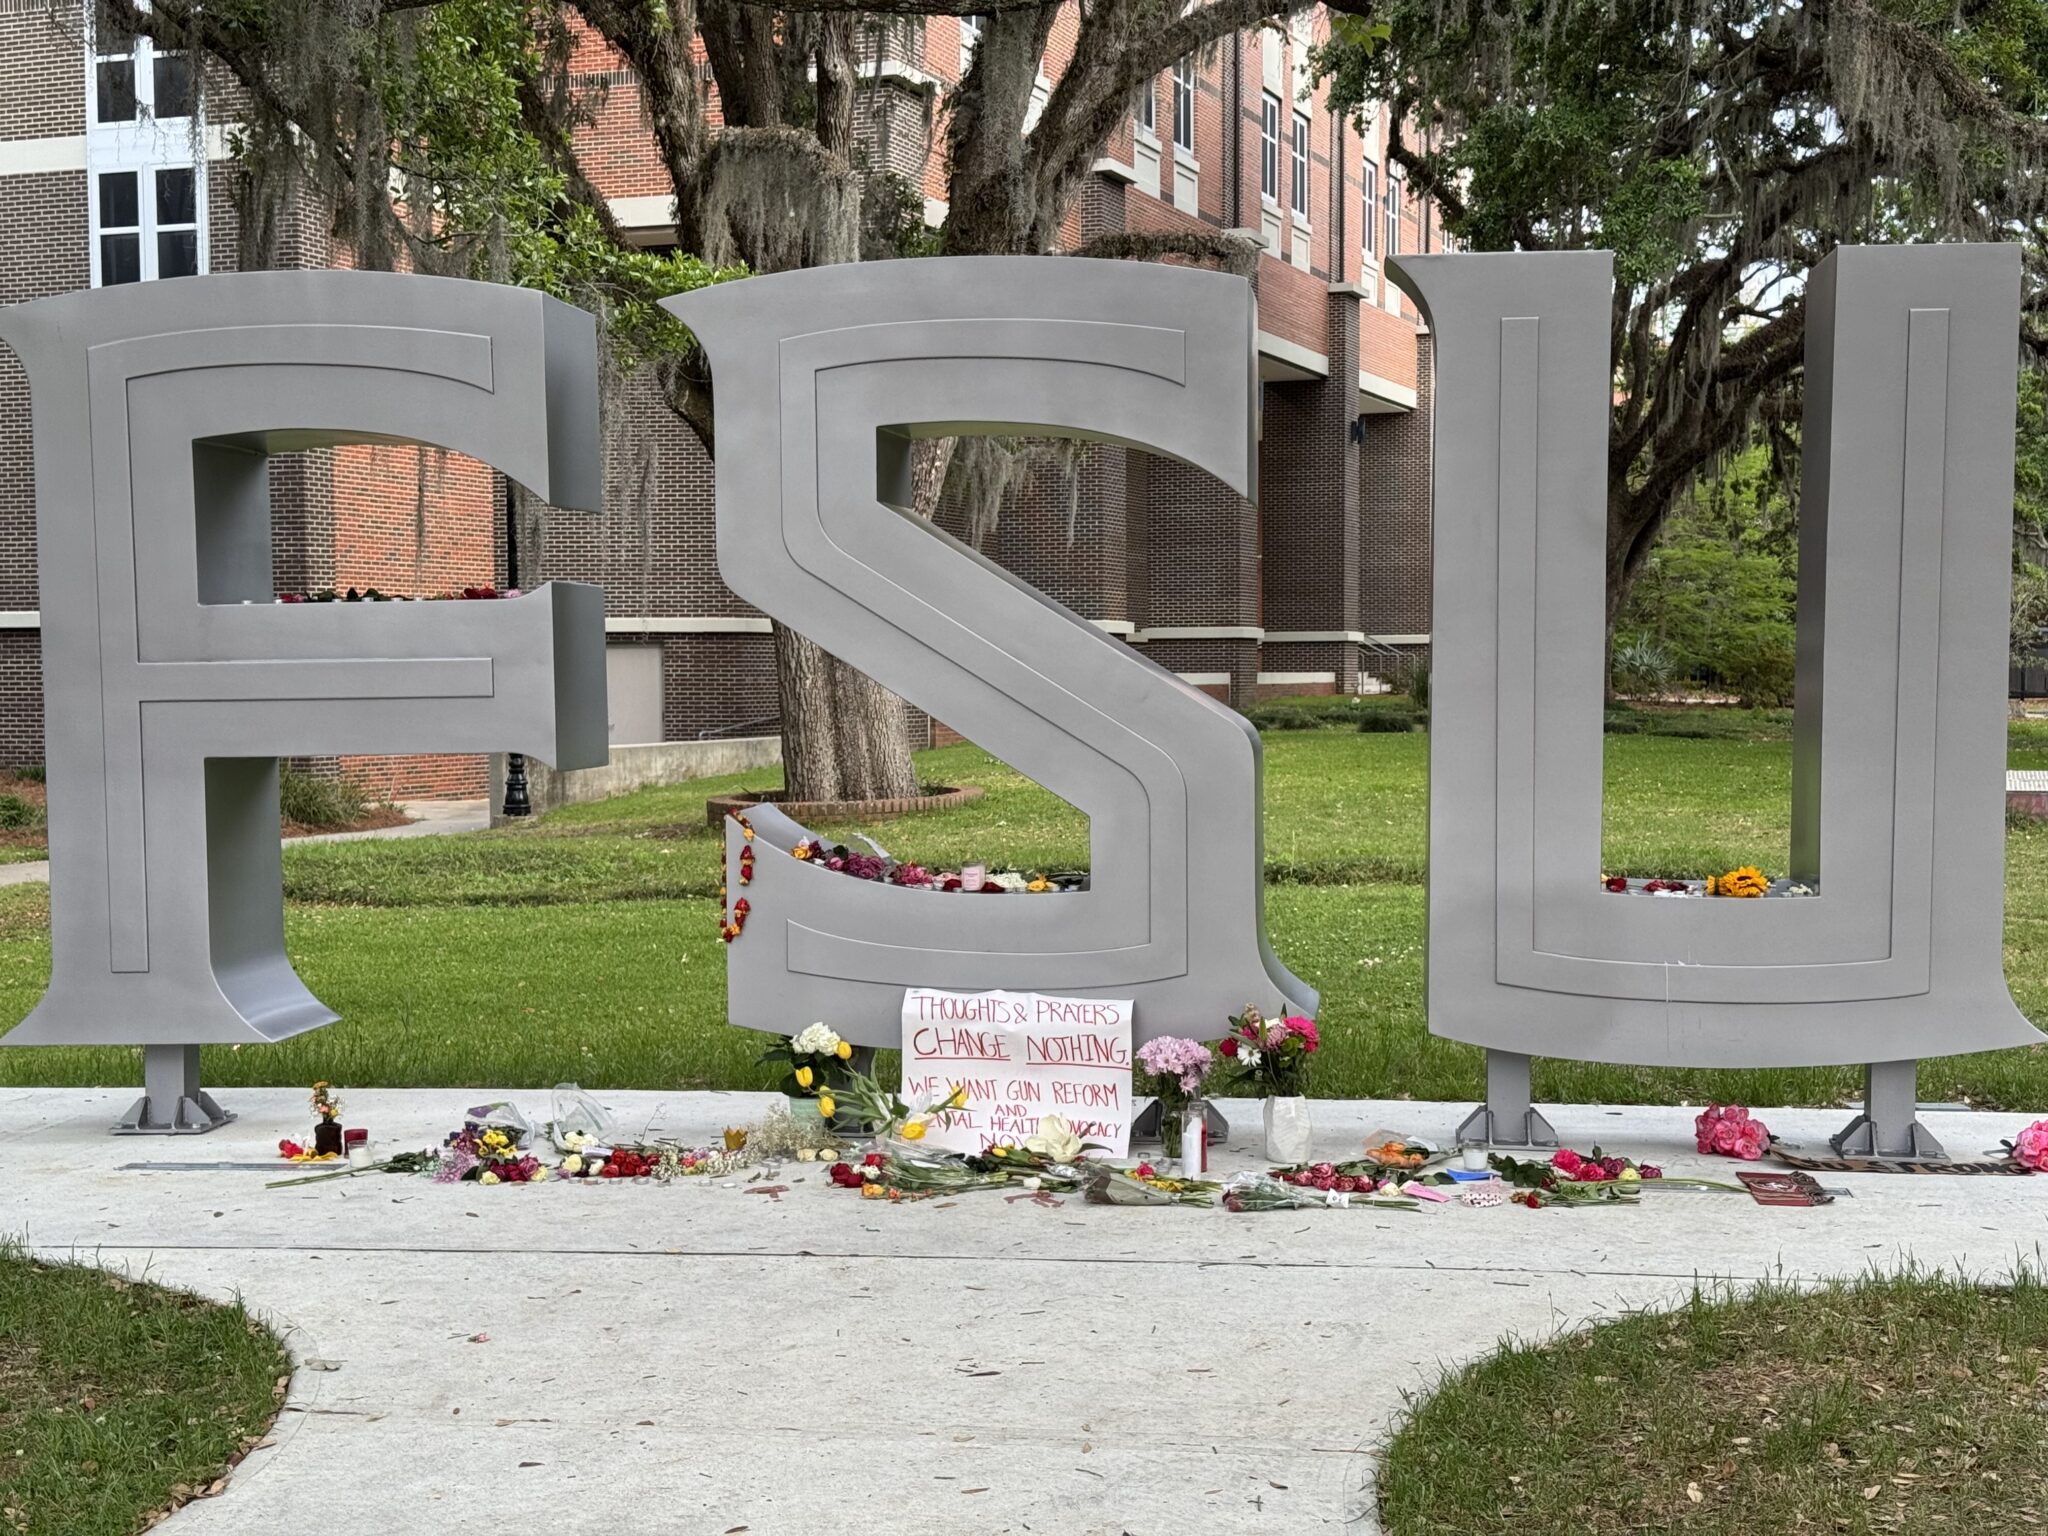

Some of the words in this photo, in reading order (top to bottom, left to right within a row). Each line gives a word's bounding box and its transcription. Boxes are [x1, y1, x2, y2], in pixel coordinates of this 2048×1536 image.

[0, 242, 2047, 1070] FSU
[911, 996, 1010, 1023] THOUGHTS
[1013, 1002, 1027, 1024] &
[1036, 1000, 1120, 1025] PRAYERS
[913, 1027, 1010, 1058] CHANGE
[1026, 1033, 1130, 1066] NOTHING.
[908, 1076, 940, 1097] WE
[1006, 1080, 1041, 1102] GUN
[1052, 1081, 1119, 1111] REFORM
[927, 1110, 983, 1129] NTAL
[1066, 1119, 1122, 1138] VOCACY
[995, 1104, 1027, 1118] AND
